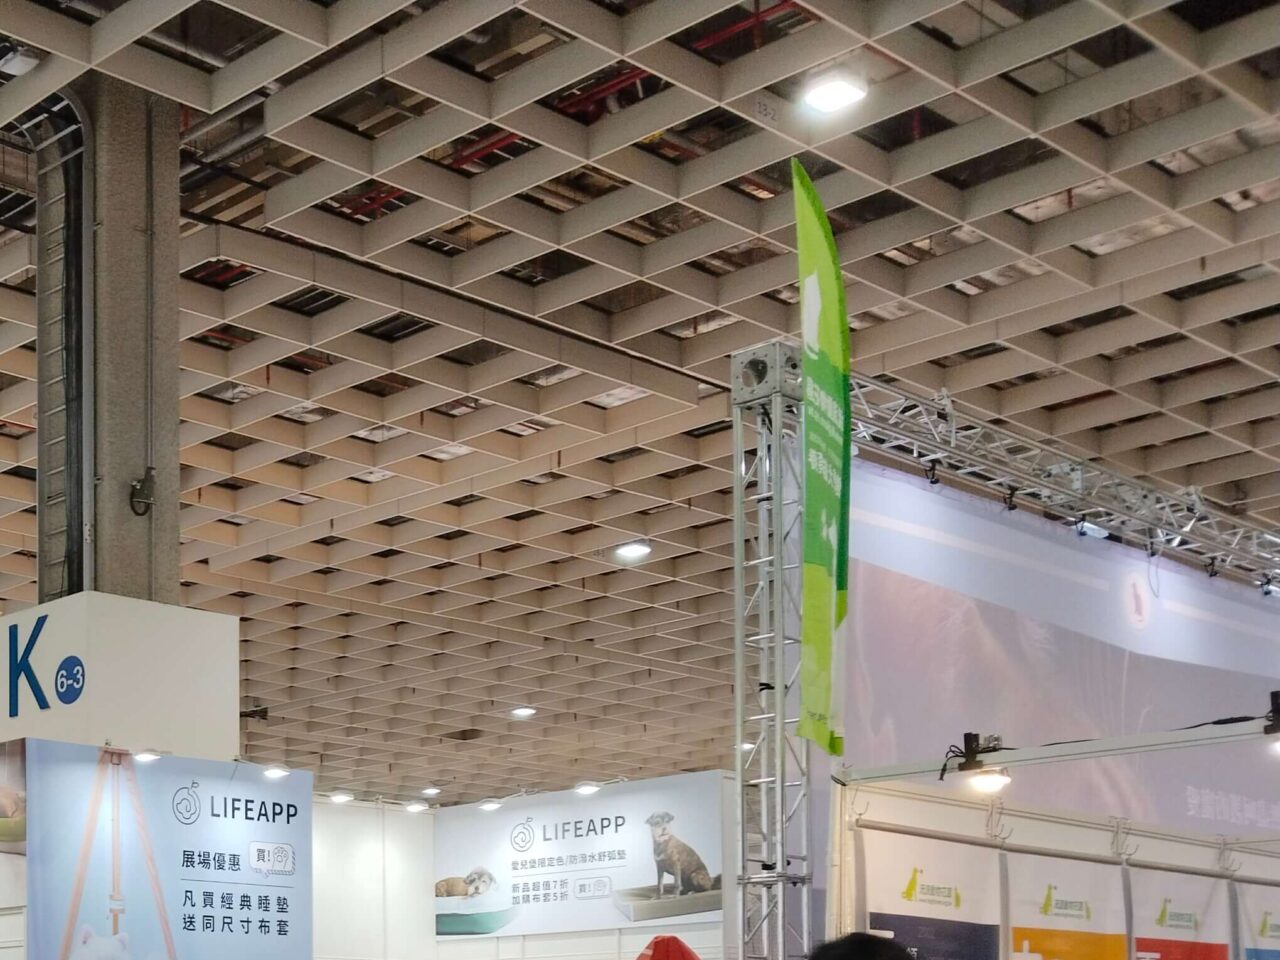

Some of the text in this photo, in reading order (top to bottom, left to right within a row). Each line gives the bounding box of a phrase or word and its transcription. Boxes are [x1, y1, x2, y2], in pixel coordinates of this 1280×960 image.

[9, 614, 83, 718] K 6-3
[210, 795, 298, 825] LIFEAPP
[542, 815, 626, 841] LIFEAPP
[181, 849, 242, 872] 展場優惠
[182, 890, 289, 914] 凡買經典睡墊
[182, 913, 289, 936] 送同尺寸布套
